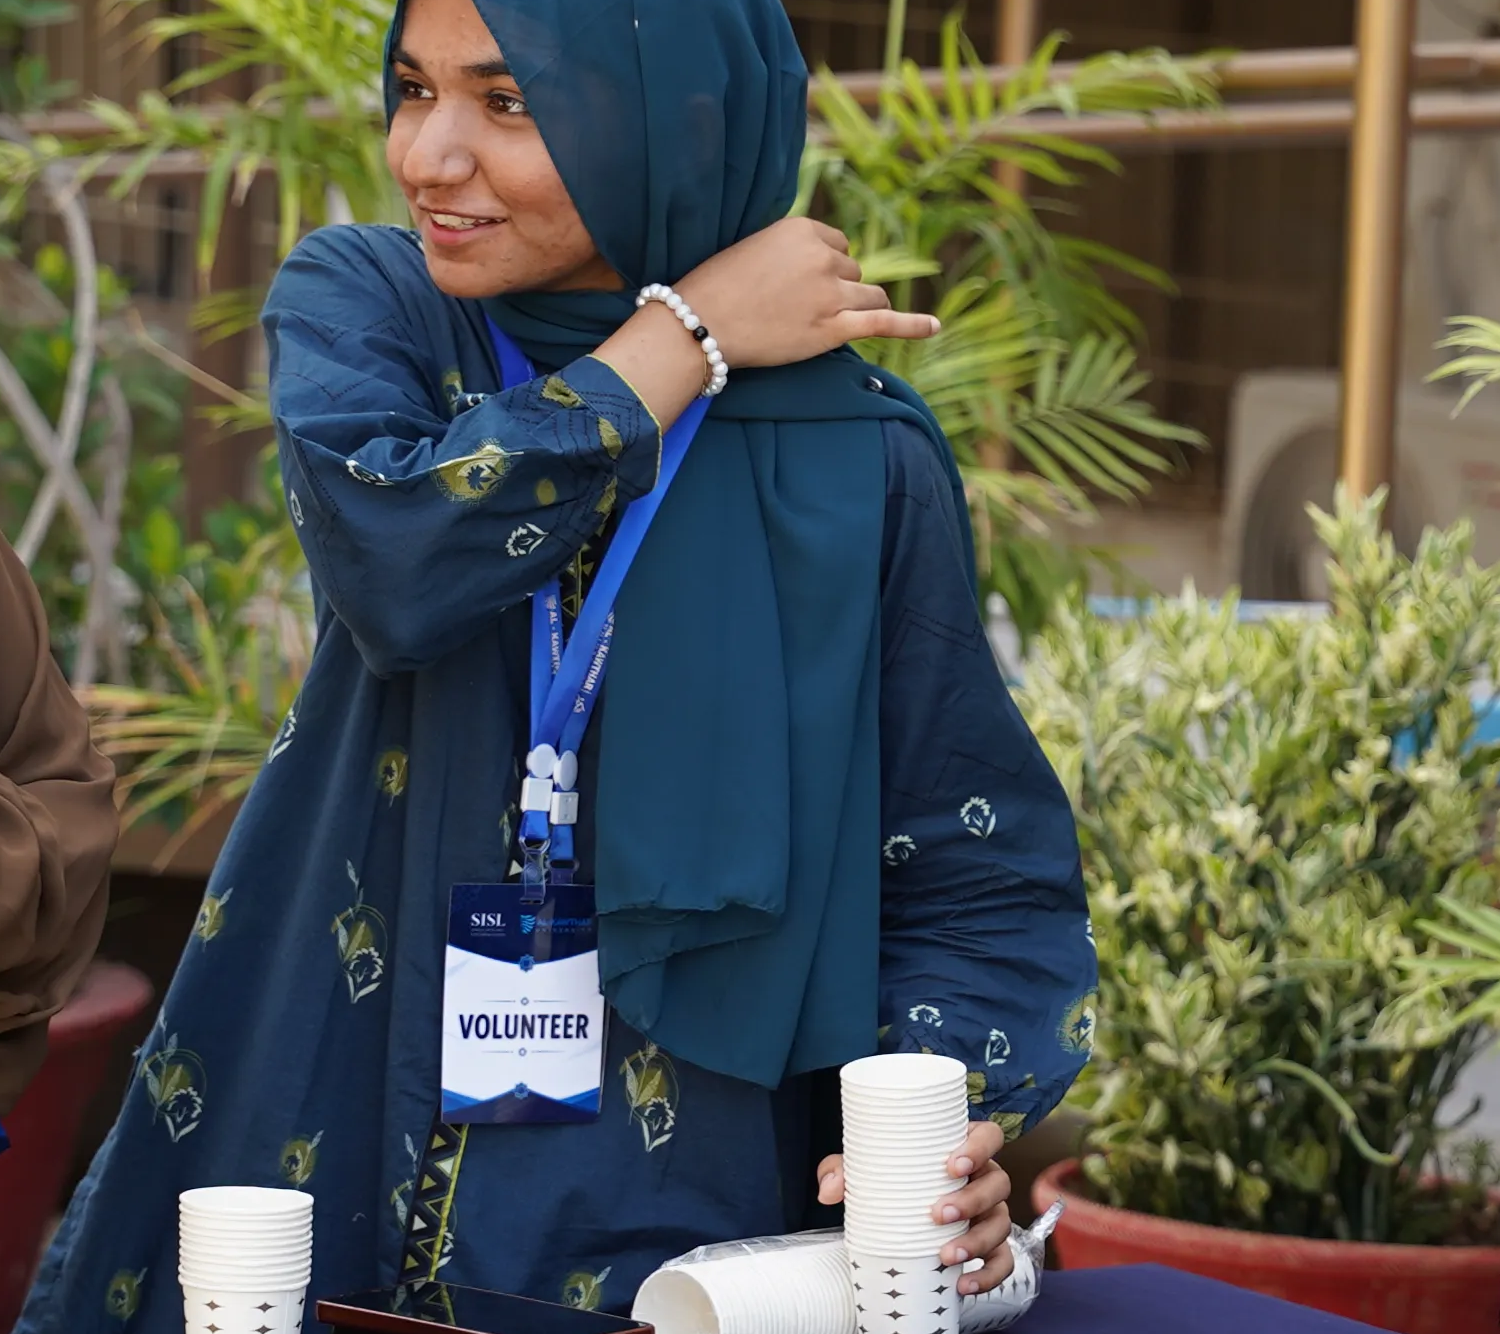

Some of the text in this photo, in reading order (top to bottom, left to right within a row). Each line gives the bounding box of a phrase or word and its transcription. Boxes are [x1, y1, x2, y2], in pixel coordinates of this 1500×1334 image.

[583, 644, 609, 691] KAWTHAR
[470, 913, 506, 927] SISL
[459, 1014, 589, 1039] VOLUNTEER
